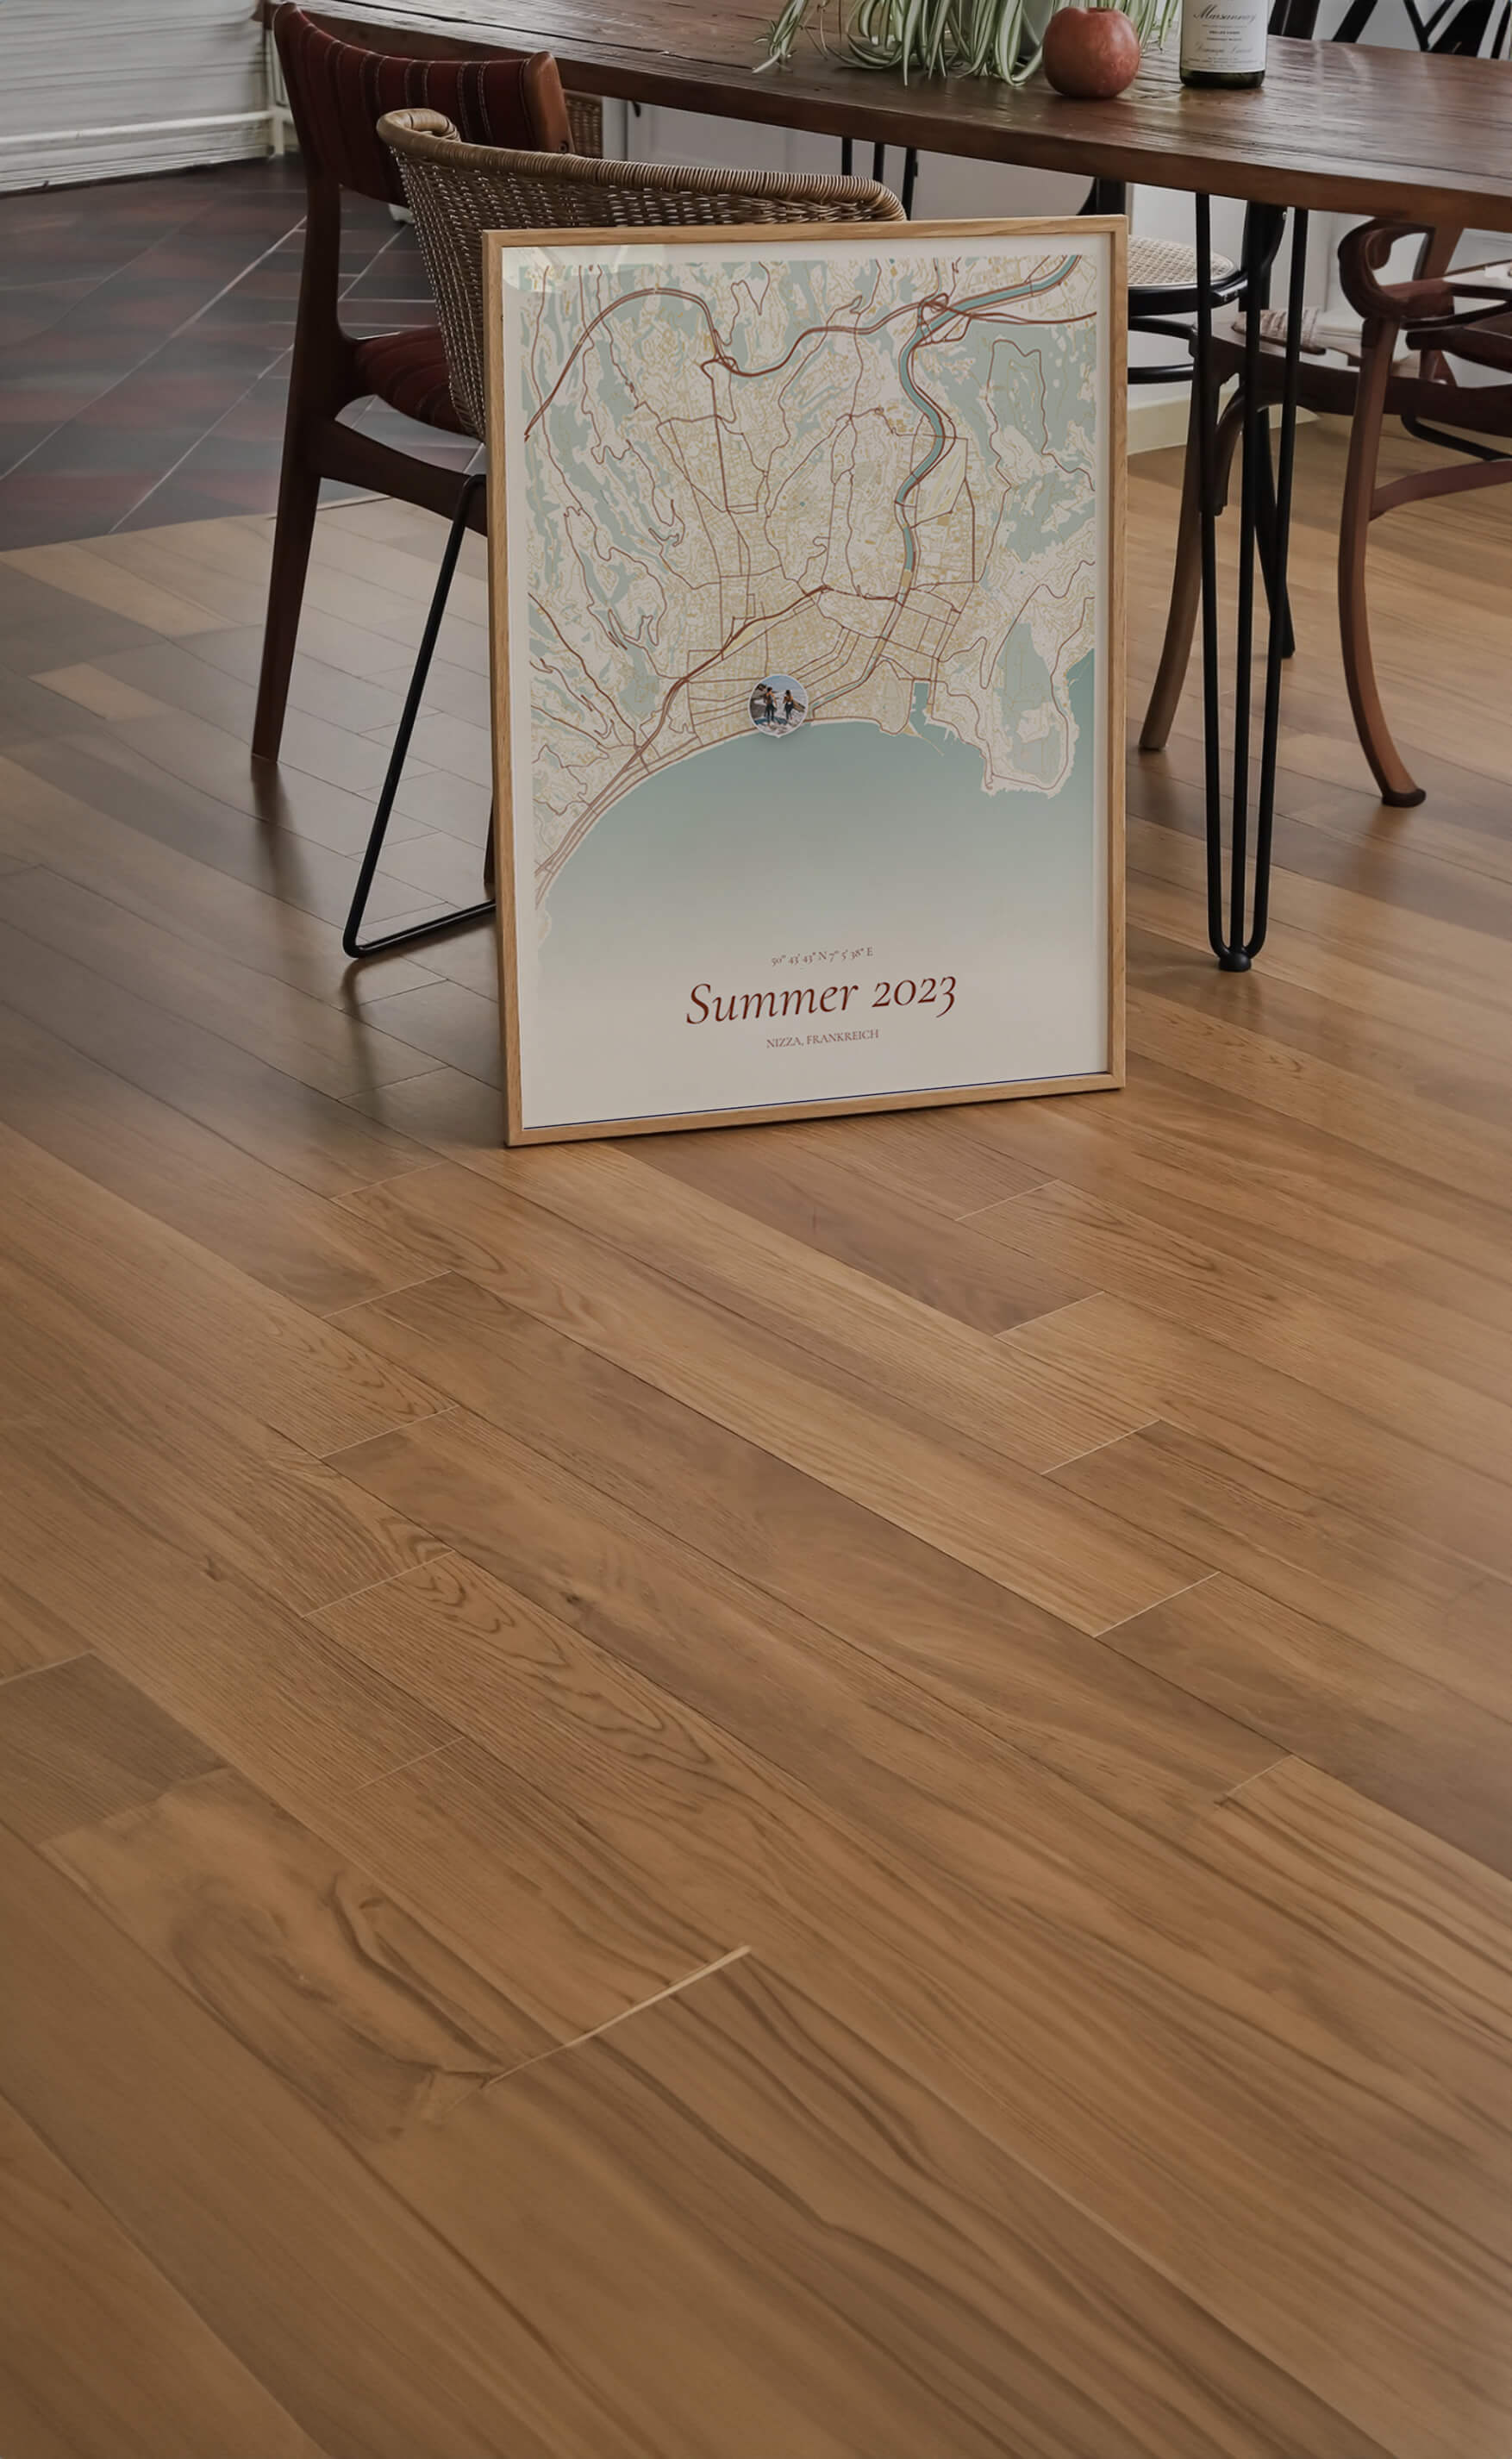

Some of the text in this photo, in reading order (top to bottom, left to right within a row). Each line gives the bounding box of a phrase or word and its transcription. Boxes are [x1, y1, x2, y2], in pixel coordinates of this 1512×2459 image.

[818, 951, 828, 960] N
[865, 947, 873, 957] E
[686, 975, 957, 1025] Summer 2023
[766, 1029, 879, 1048] NIZZA, FRANKREICH
